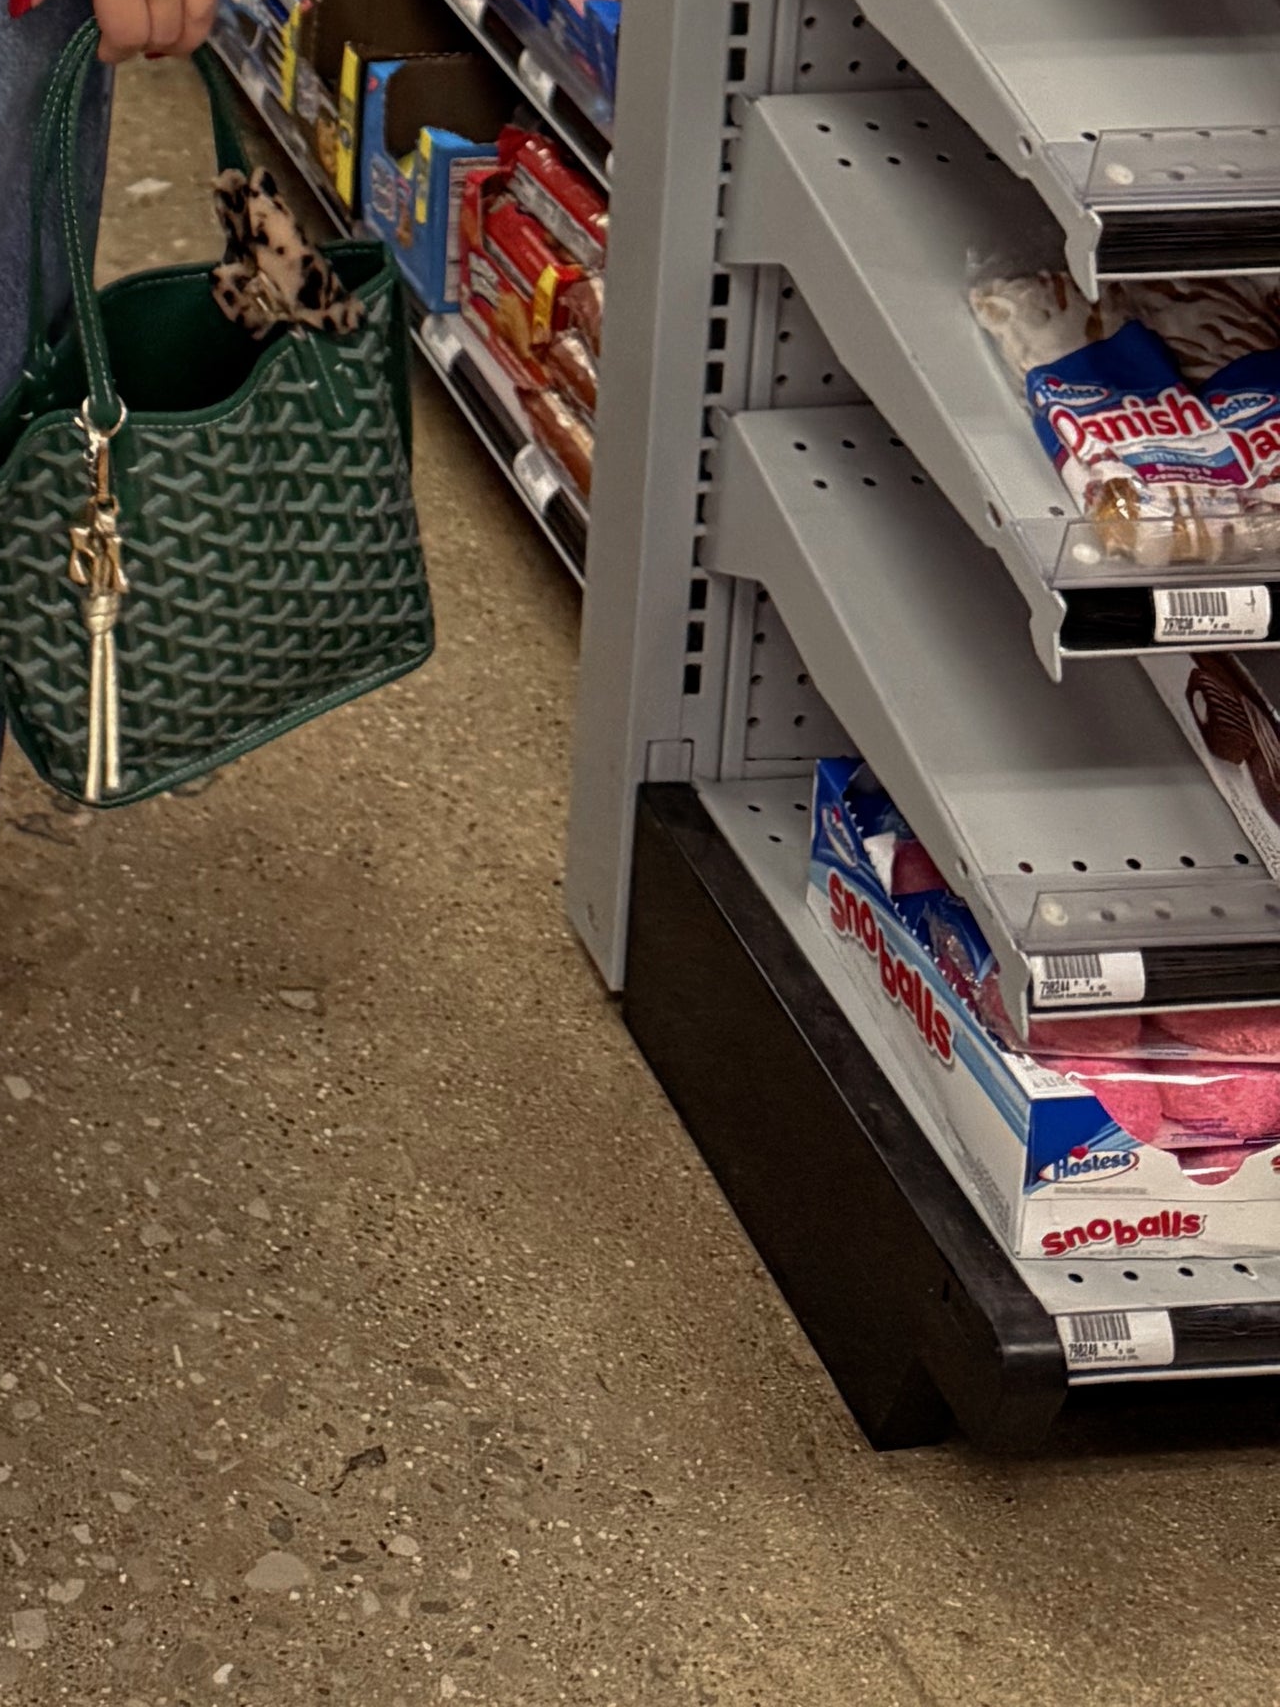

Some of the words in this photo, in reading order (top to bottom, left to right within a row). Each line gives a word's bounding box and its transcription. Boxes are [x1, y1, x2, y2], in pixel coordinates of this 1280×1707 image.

[1218, 395, 1269, 419] ostess
[1050, 389, 1214, 459] Danish
[1053, 1149, 1133, 1181] Hostess
